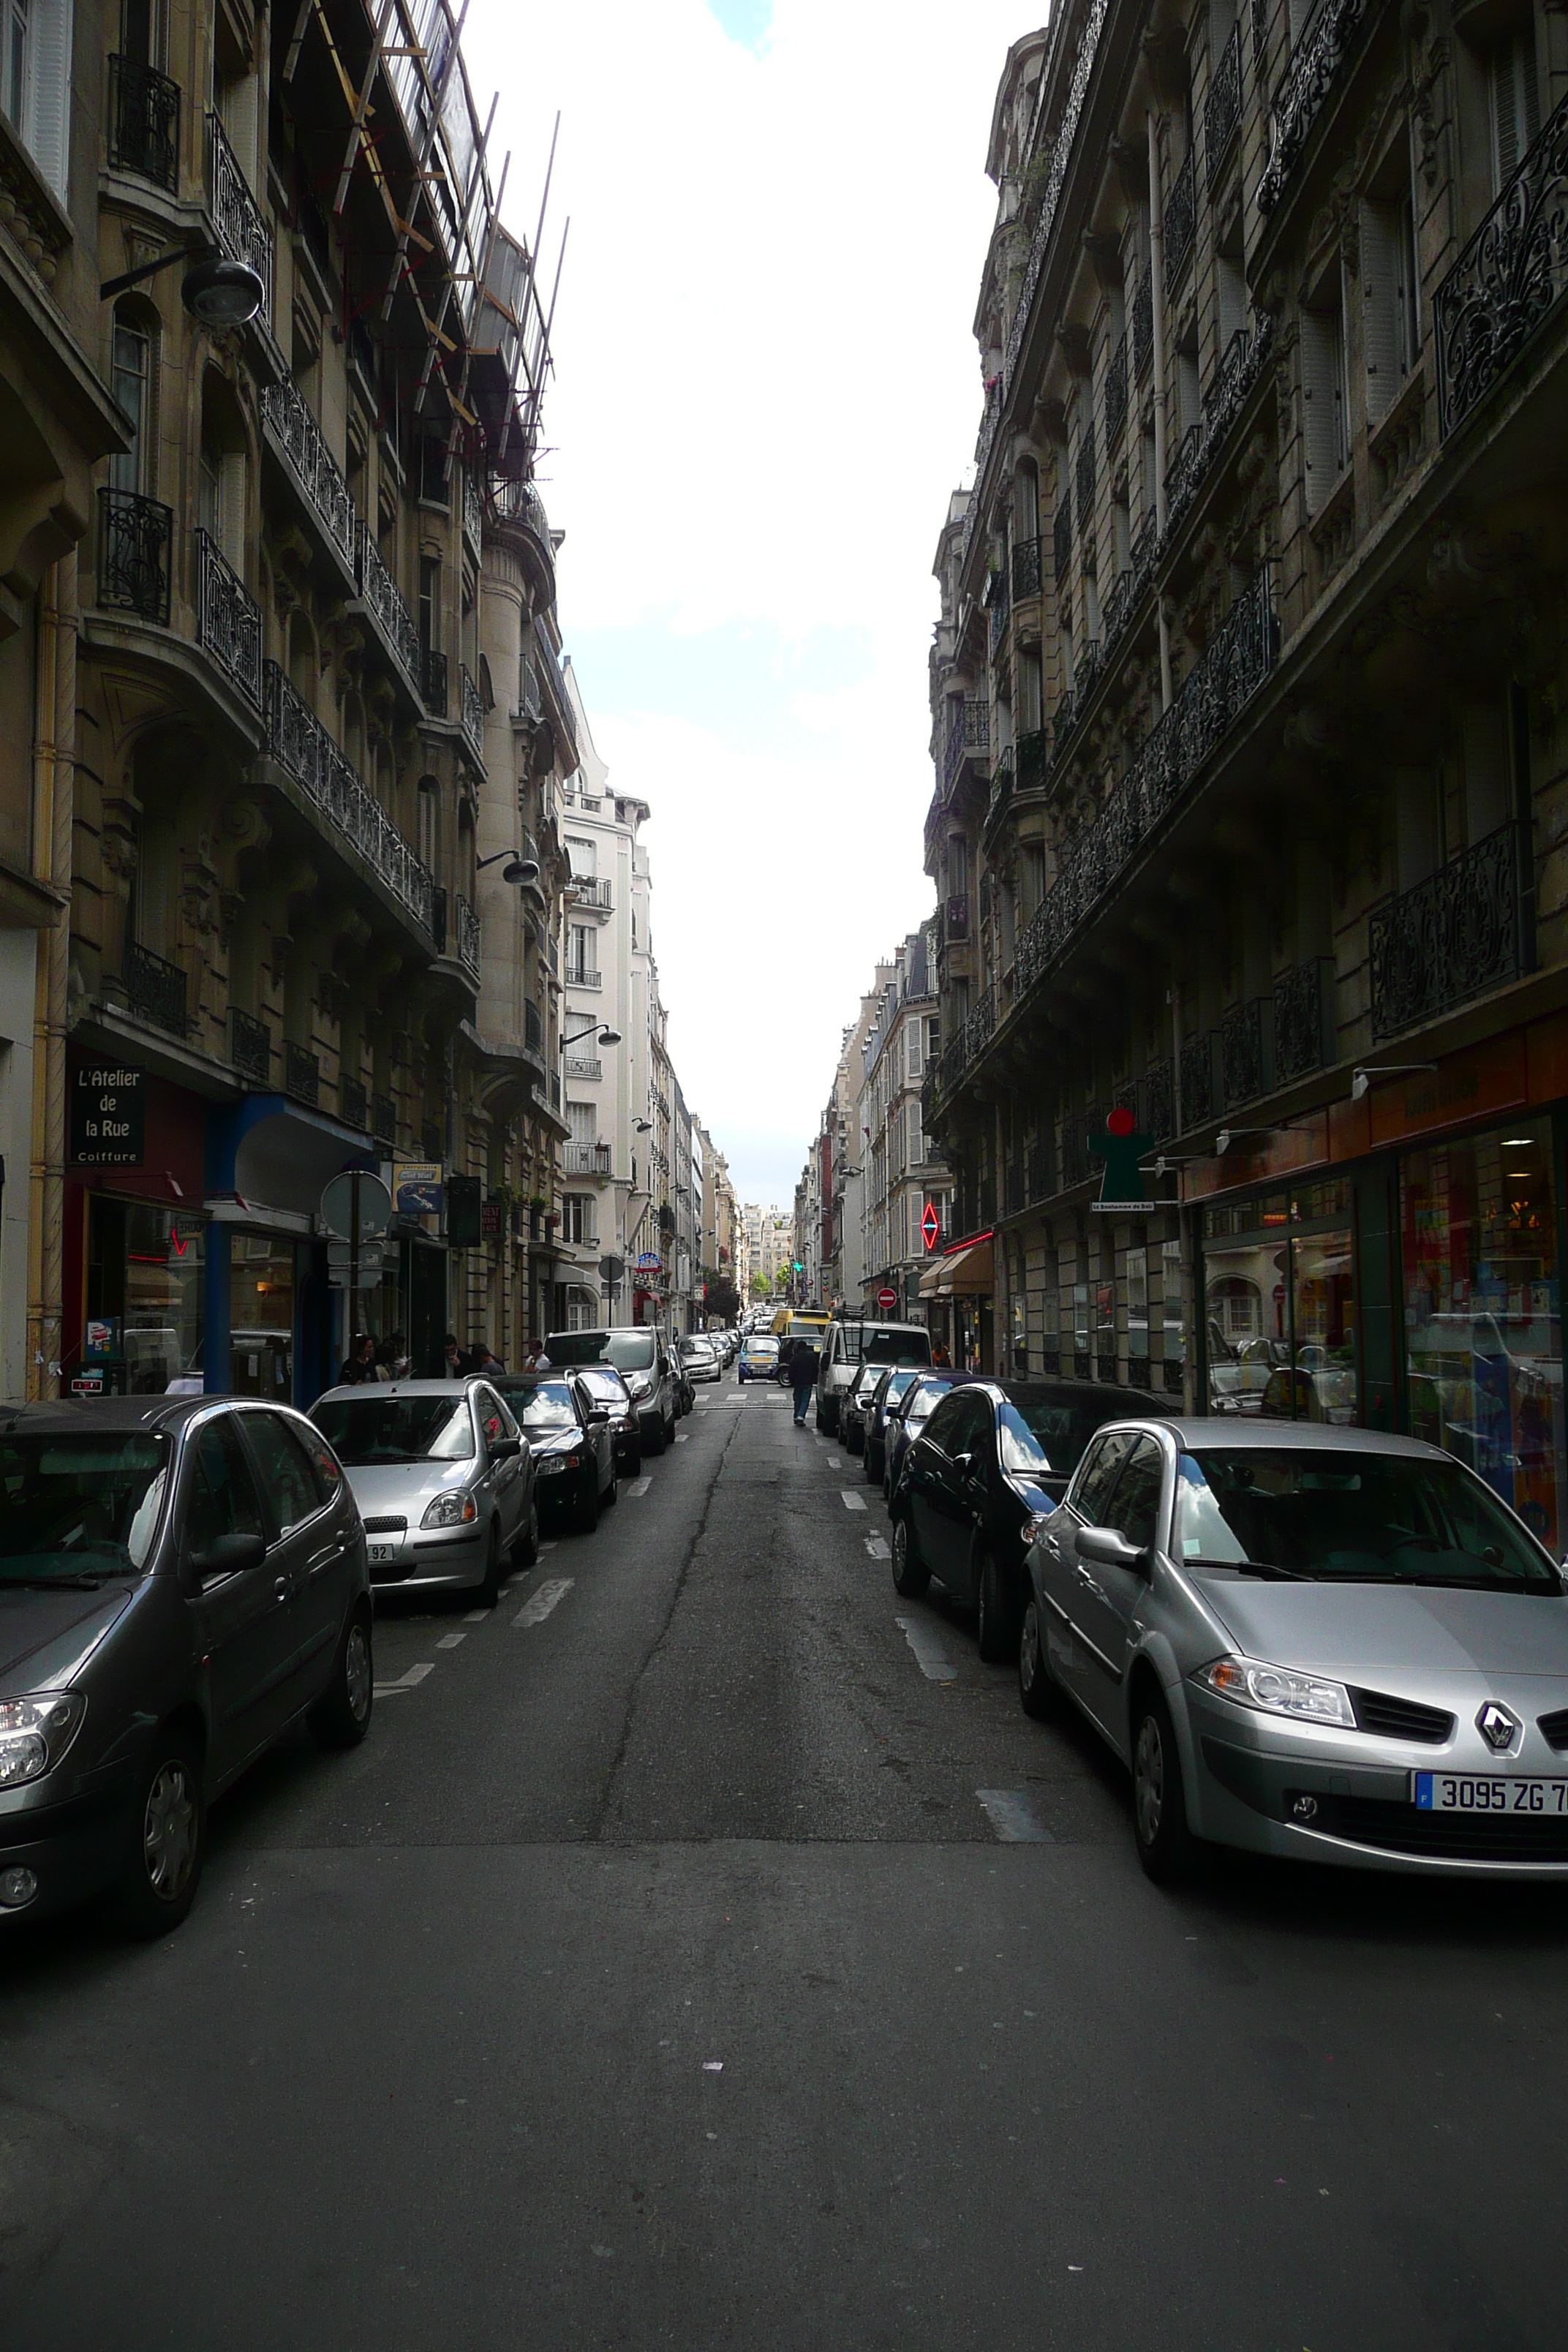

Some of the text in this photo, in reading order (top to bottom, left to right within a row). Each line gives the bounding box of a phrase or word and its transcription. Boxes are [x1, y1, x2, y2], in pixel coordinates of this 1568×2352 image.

[78, 1069, 140, 1087] L'Atelier
[99, 1094, 117, 1112] de
[86, 1120, 130, 1137] la Rue
[78, 1152, 137, 1161] Coiffure
[372, 1546, 386, 1559] 92
[1421, 1795, 1428, 1803] F
[1441, 1779, 1568, 1812] 3095 ZG 7
